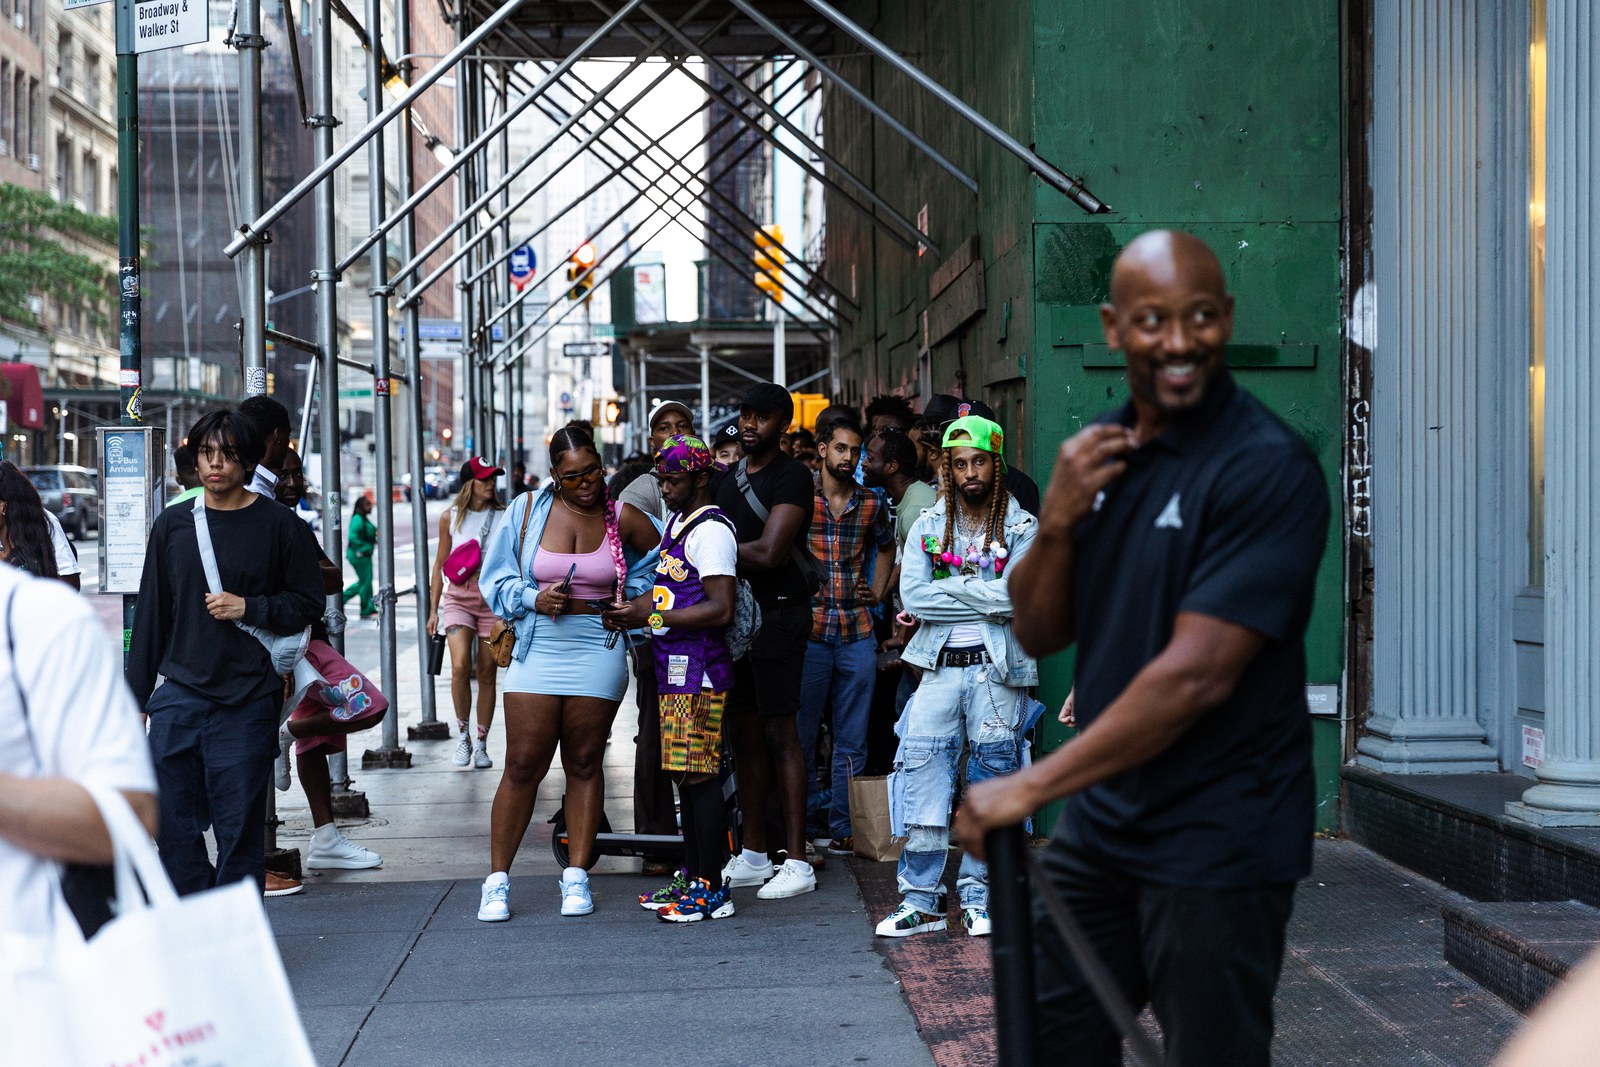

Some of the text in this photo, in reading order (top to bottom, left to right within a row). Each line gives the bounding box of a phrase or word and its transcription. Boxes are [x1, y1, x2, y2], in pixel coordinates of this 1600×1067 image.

[139, 0, 189, 20] Broadway &
[139, 20, 179, 39] Walker St
[109, 465, 138, 473] Arrivals
